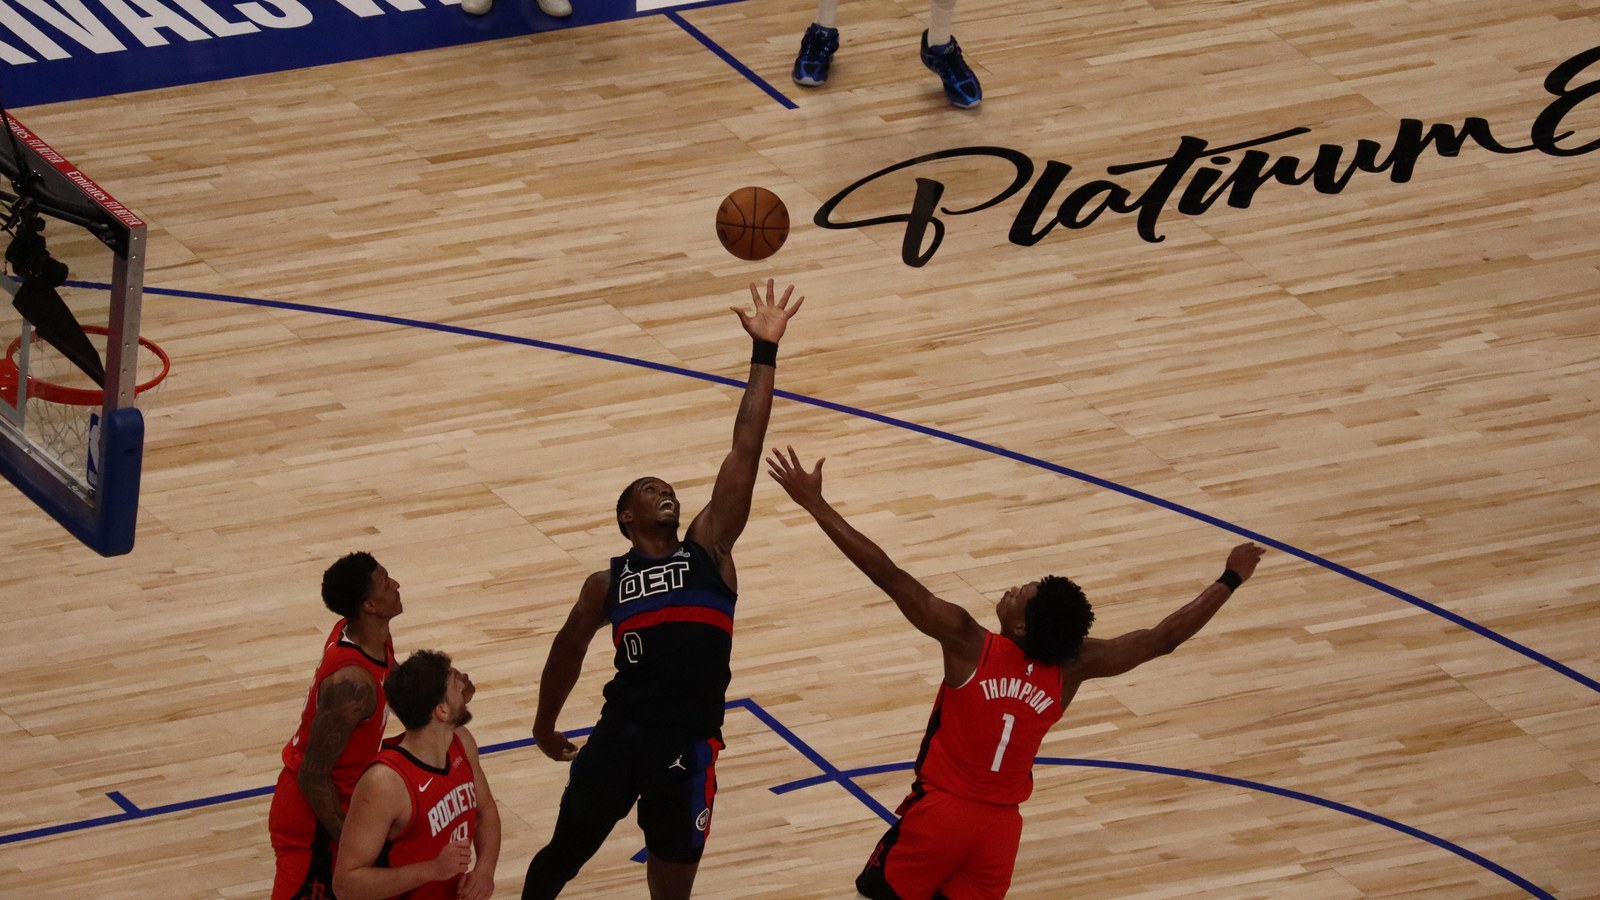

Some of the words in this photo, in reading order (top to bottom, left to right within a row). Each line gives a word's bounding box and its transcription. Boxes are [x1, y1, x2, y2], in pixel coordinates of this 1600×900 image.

[0, 0, 313, 65] IVALS
[66, 170, 109, 201] Emirates
[814, 117, 1535, 267] Platinum
[619, 561, 690, 603] DET
[624, 632, 643, 663] 0
[979, 677, 1055, 715] THOMPSON
[990, 713, 1015, 772] 1
[427, 781, 477, 838] ROCKETS
